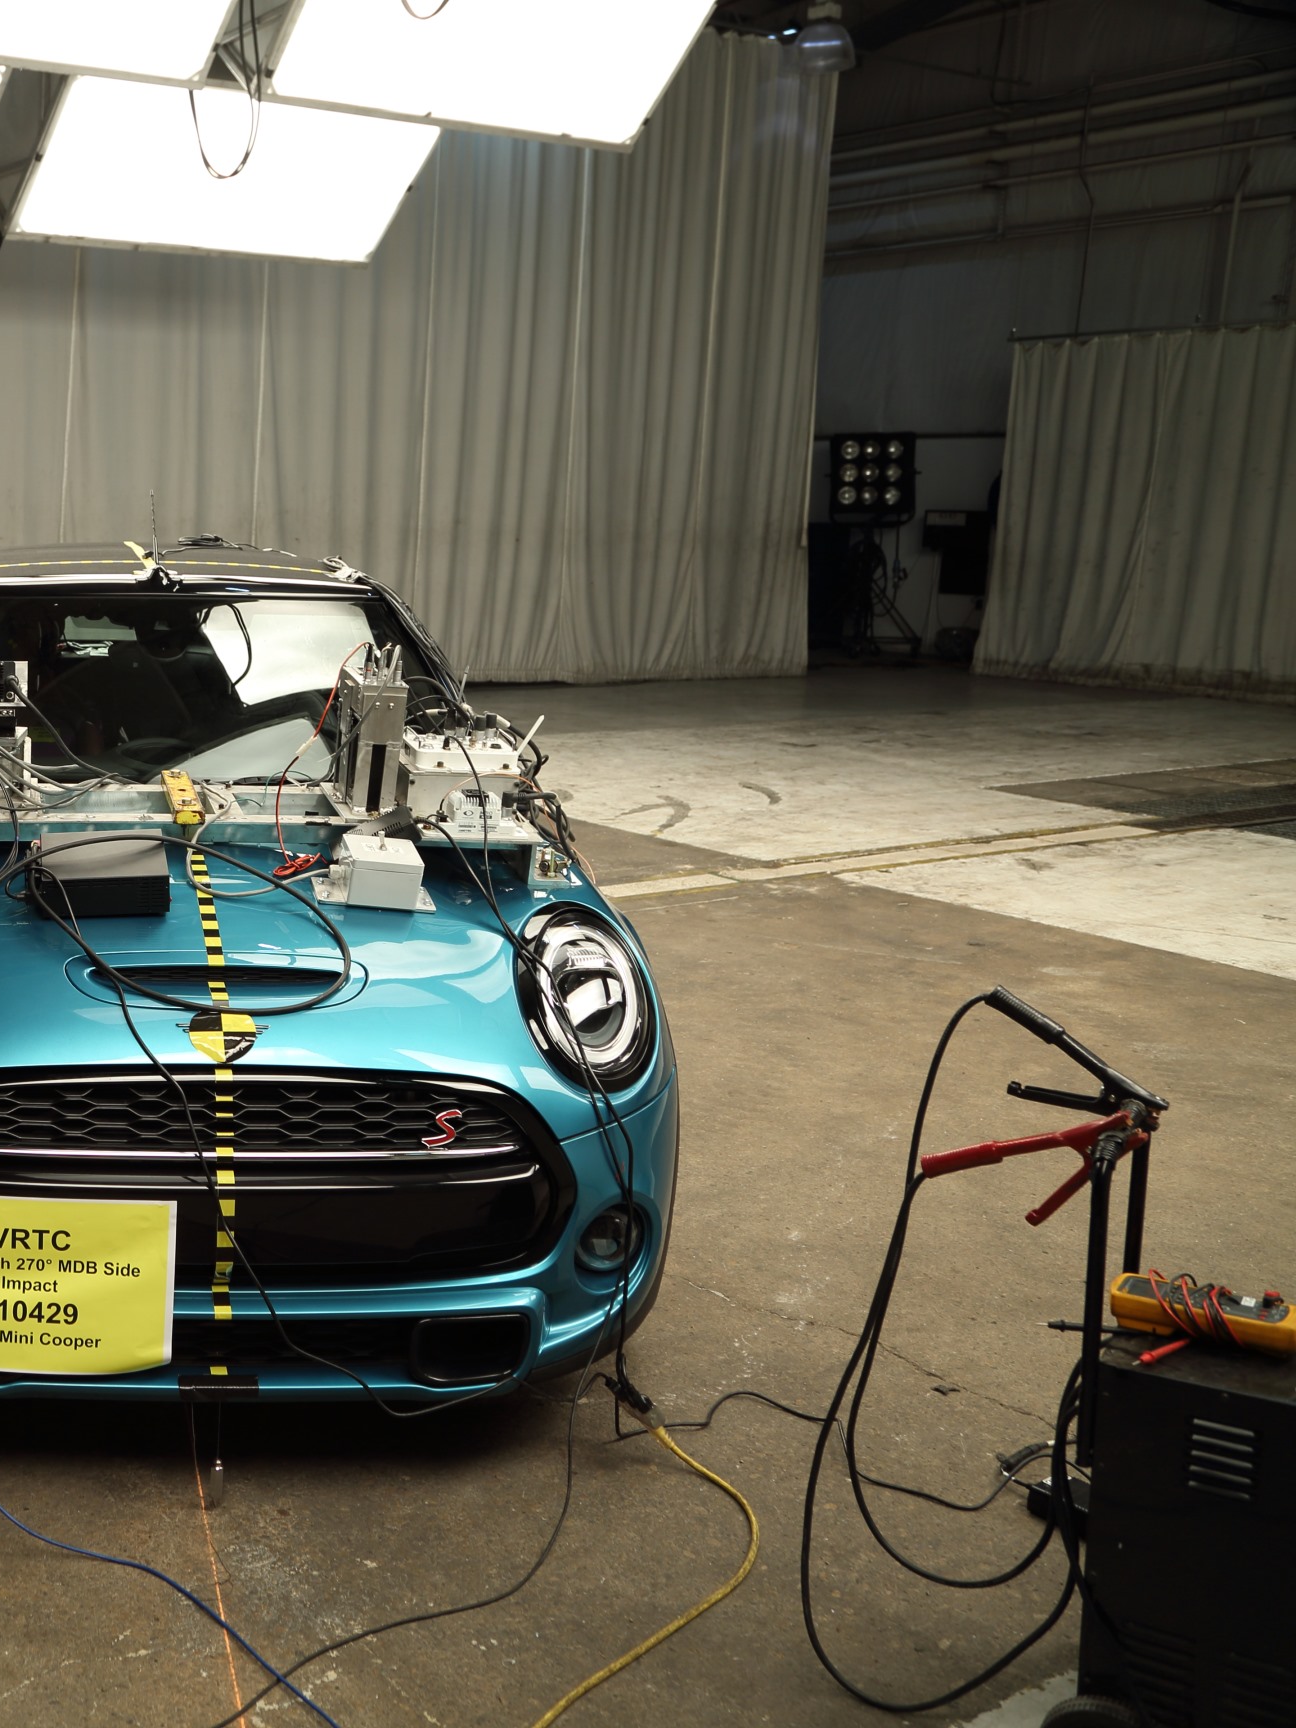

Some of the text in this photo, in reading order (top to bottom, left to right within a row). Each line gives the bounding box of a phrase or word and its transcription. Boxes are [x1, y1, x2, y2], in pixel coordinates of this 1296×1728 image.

[421, 1109, 462, 1147] S
[16, 1258, 53, 1272] 270°
[58, 1259, 98, 1275] MDB
[103, 1262, 141, 1278] Side
[1, 1275, 58, 1294] Impact
[0, 1330, 34, 1345] Mini
[39, 1332, 102, 1351] Cooper
